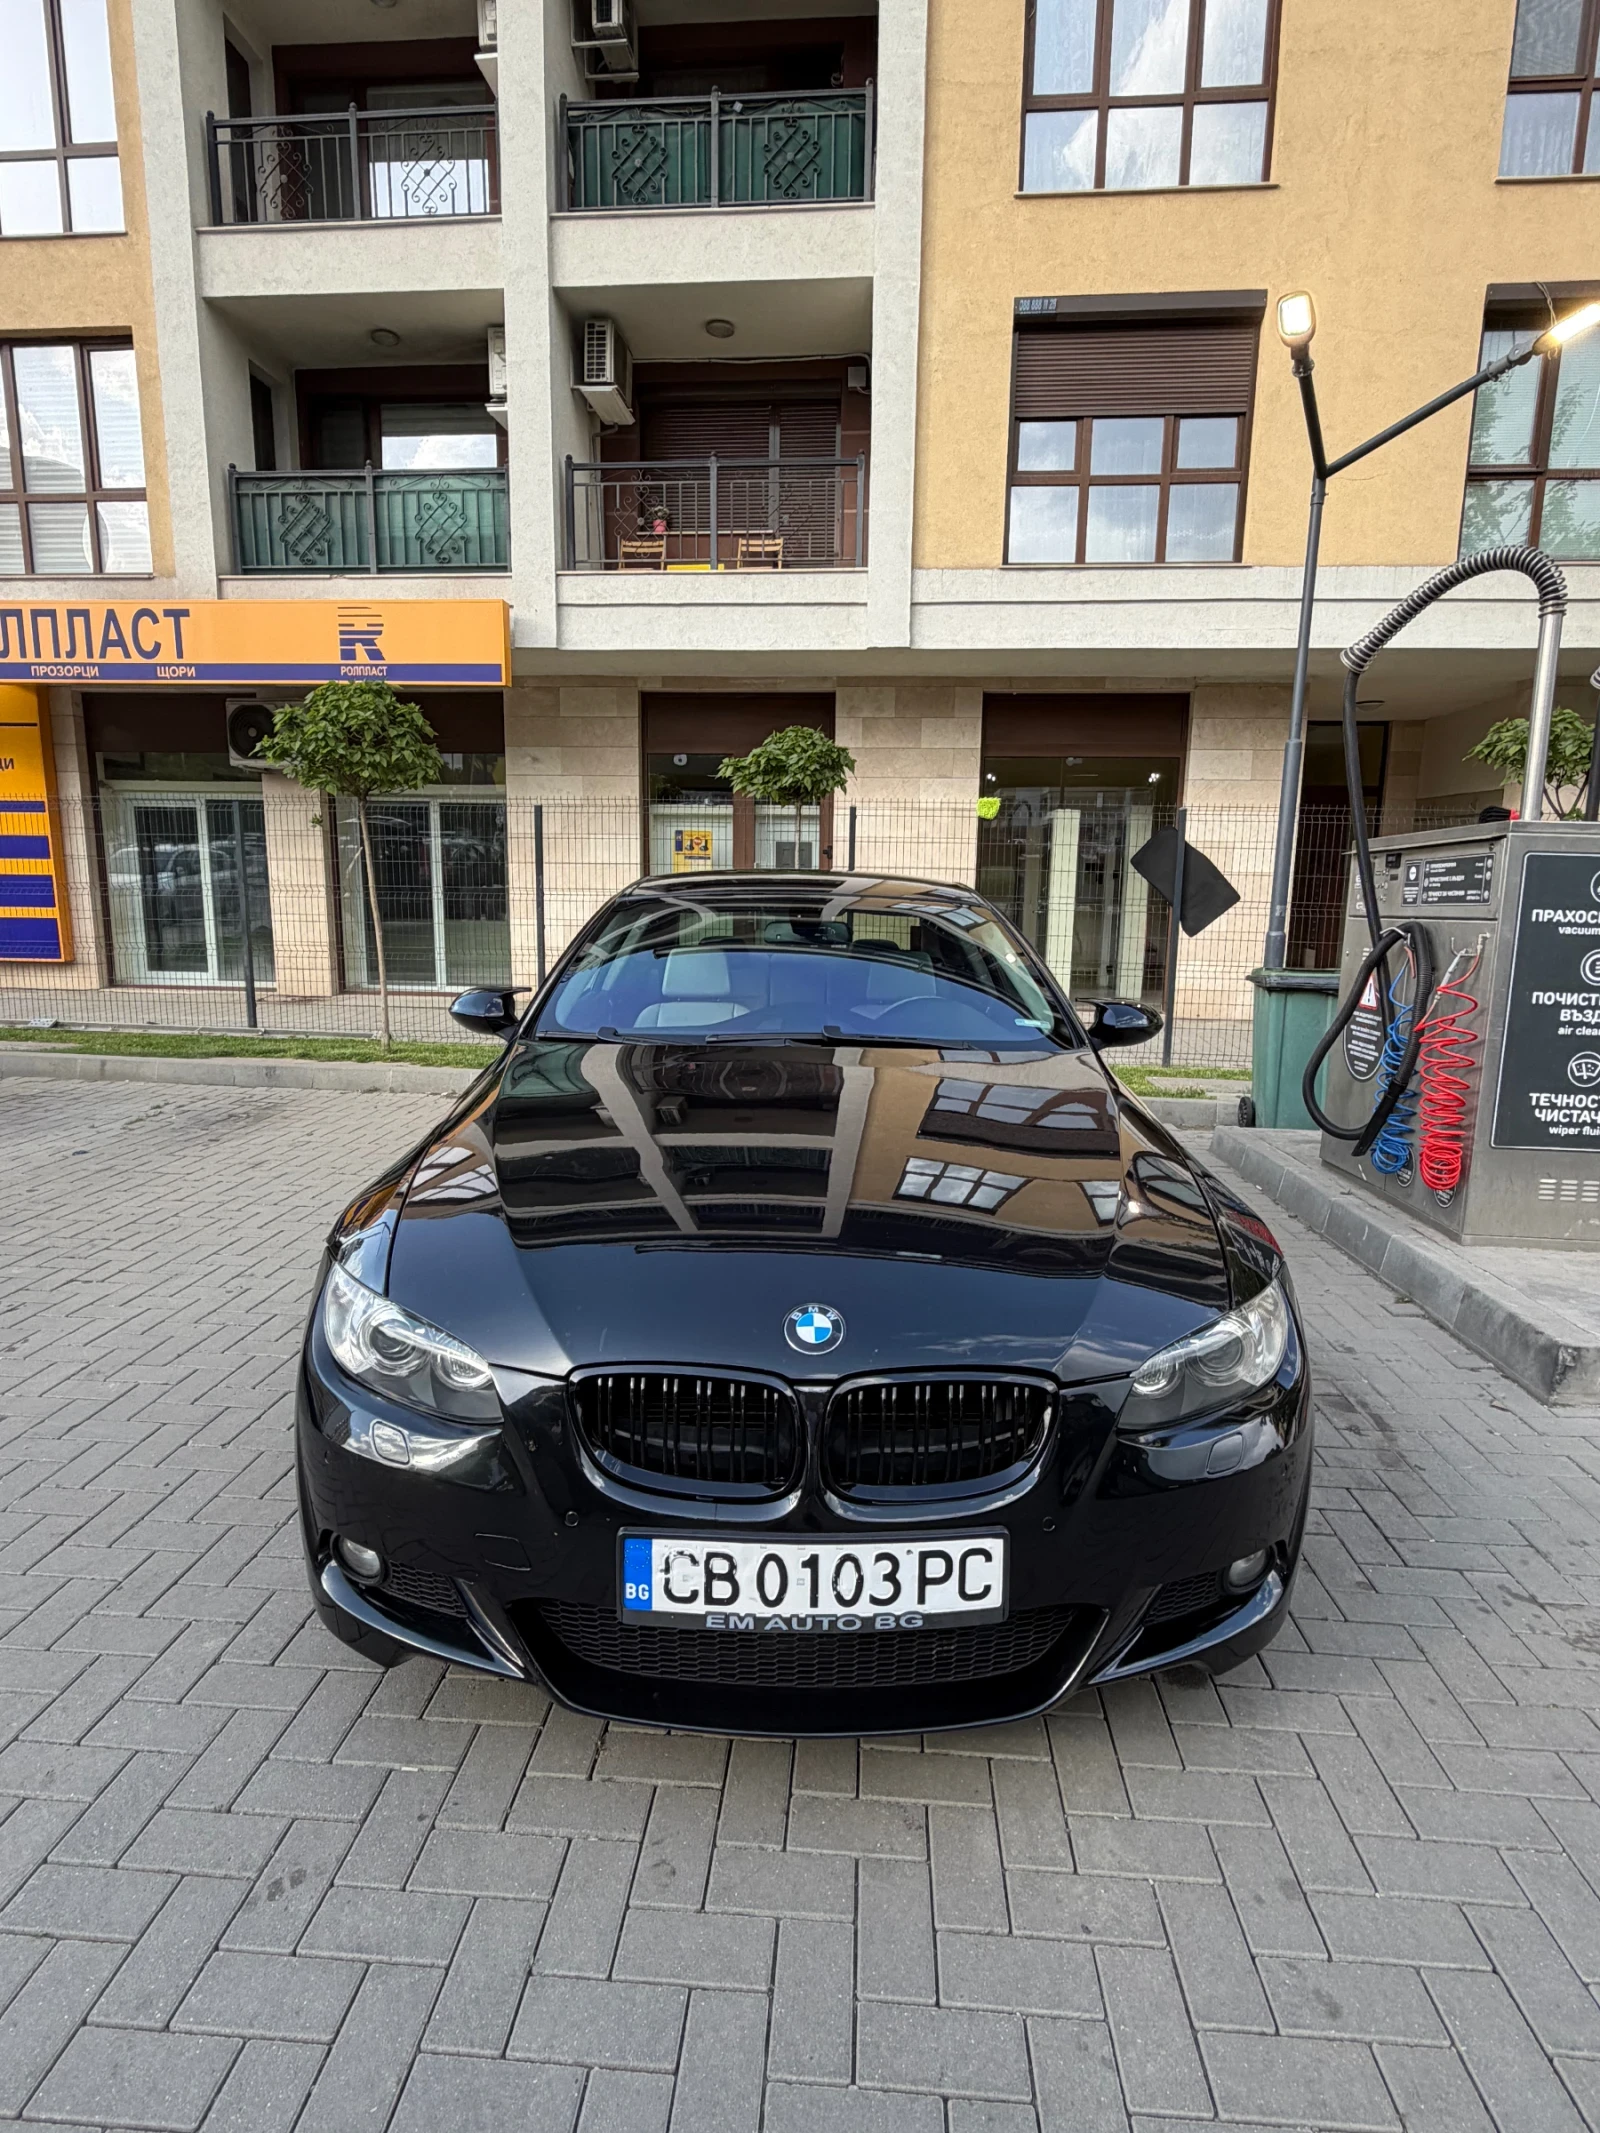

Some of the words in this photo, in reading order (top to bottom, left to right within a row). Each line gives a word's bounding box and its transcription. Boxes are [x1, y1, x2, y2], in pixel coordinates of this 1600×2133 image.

[0, 607, 190, 660] ЛПЛАСТ
[31, 666, 99, 679] ПРОЗОРЦИ
[157, 666, 196, 679] ЩОРИ
[341, 666, 388, 677] РОЛПЛАСТ
[1532, 909, 1600, 924] ПРАХОС
[1532, 992, 1600, 1006] ПОЧИСТ
[1558, 1025, 1574, 1036] air
[1575, 1026, 1600, 1036] clea
[1529, 1093, 1600, 1108] ТЕЧНОС
[1549, 1125, 1580, 1136] wiper
[1582, 1125, 1600, 1136] flui
[791, 1306, 839, 1320] BMW
[663, 1550, 740, 1606] CB
[757, 1552, 902, 1609] 0103
[917, 1547, 993, 1605] PC
[625, 1583, 649, 1600] BG
[705, 1614, 754, 1630] EM
[764, 1614, 862, 1631] AUTO
[874, 1612, 924, 1630] BG
